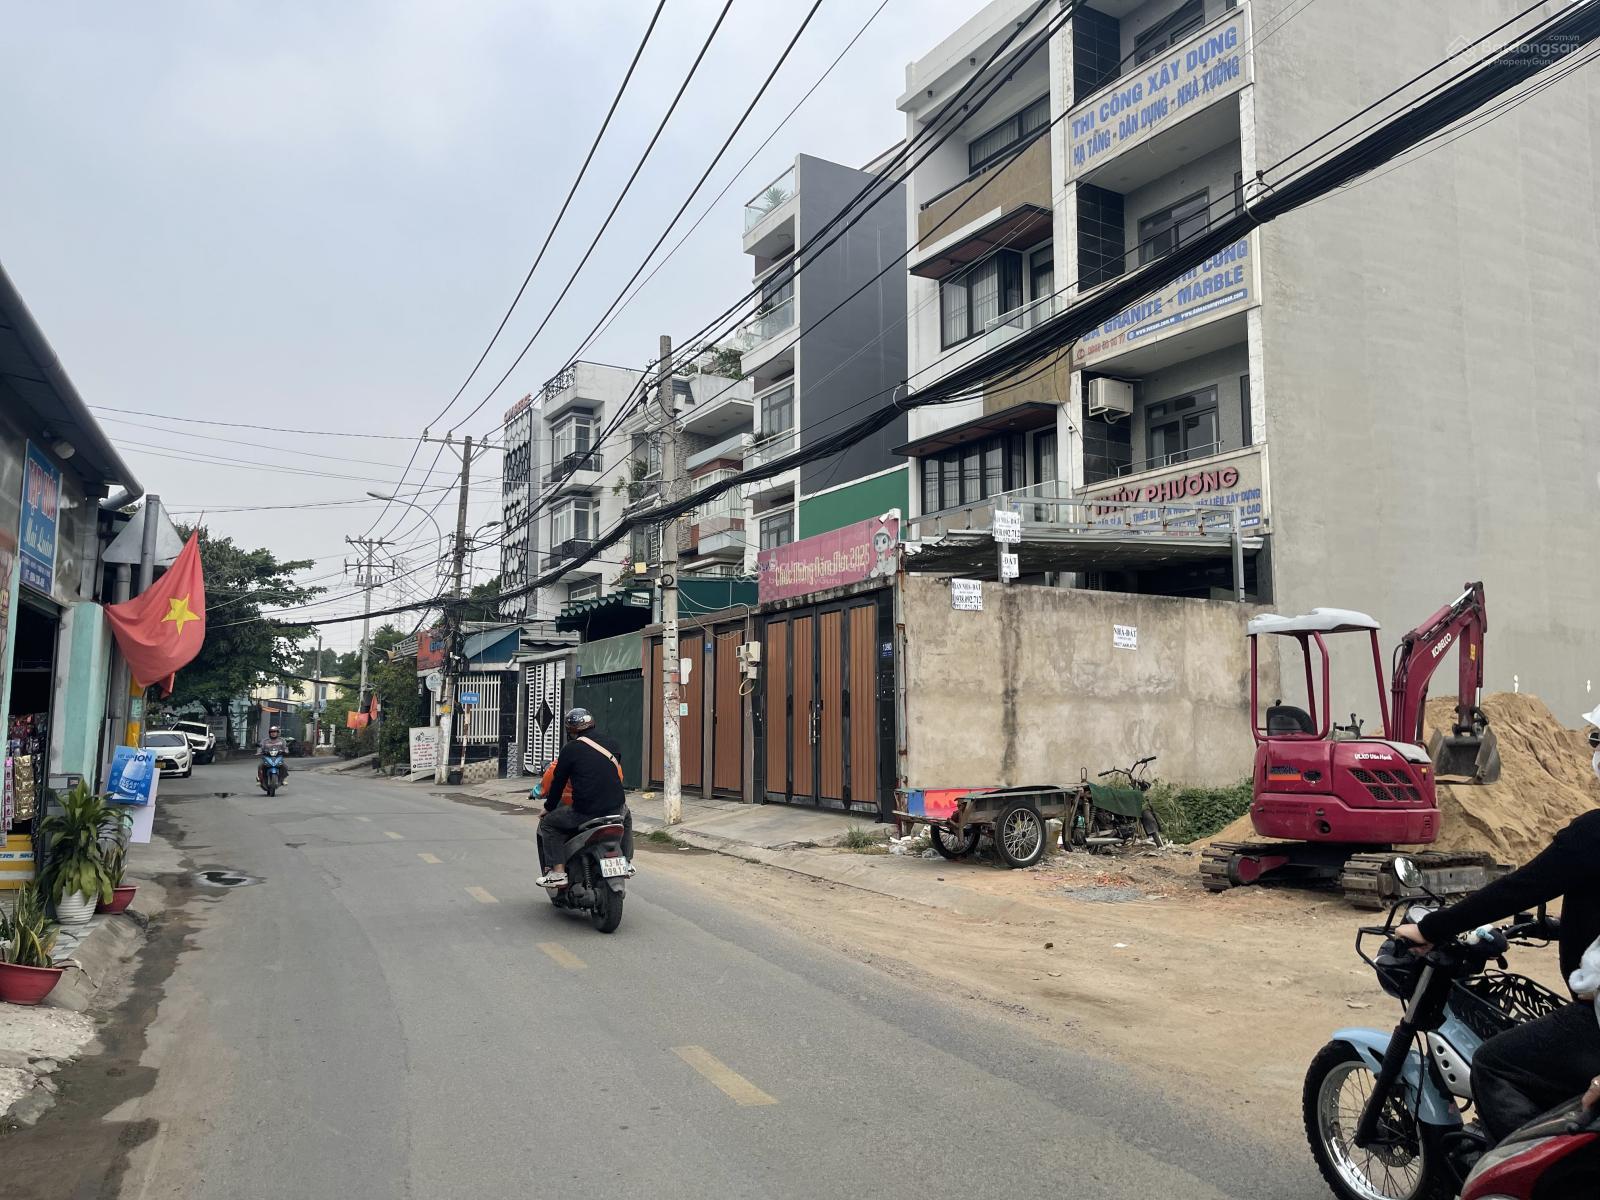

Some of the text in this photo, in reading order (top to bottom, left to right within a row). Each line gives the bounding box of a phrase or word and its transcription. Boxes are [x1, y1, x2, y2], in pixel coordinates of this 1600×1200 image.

[1072, 26, 1237, 139] THI CÔNG XÂY DỰNG
[1074, 146, 1086, 168] HẠ
[1087, 129, 1111, 156] TẦNG
[1141, 98, 1169, 128] DỤNG
[1177, 76, 1200, 108] NHÀ
[1202, 55, 1240, 94] XƯỞNG
[1103, 296, 1163, 334] GRANITE
[1177, 264, 1244, 306] MARBLE
[1144, 466, 1239, 504] PHƯƠNG
[1246, 503, 1261, 516] CAO
[1431, 632, 1452, 659] KOBELCO
[134, 754, 153, 762] ION
